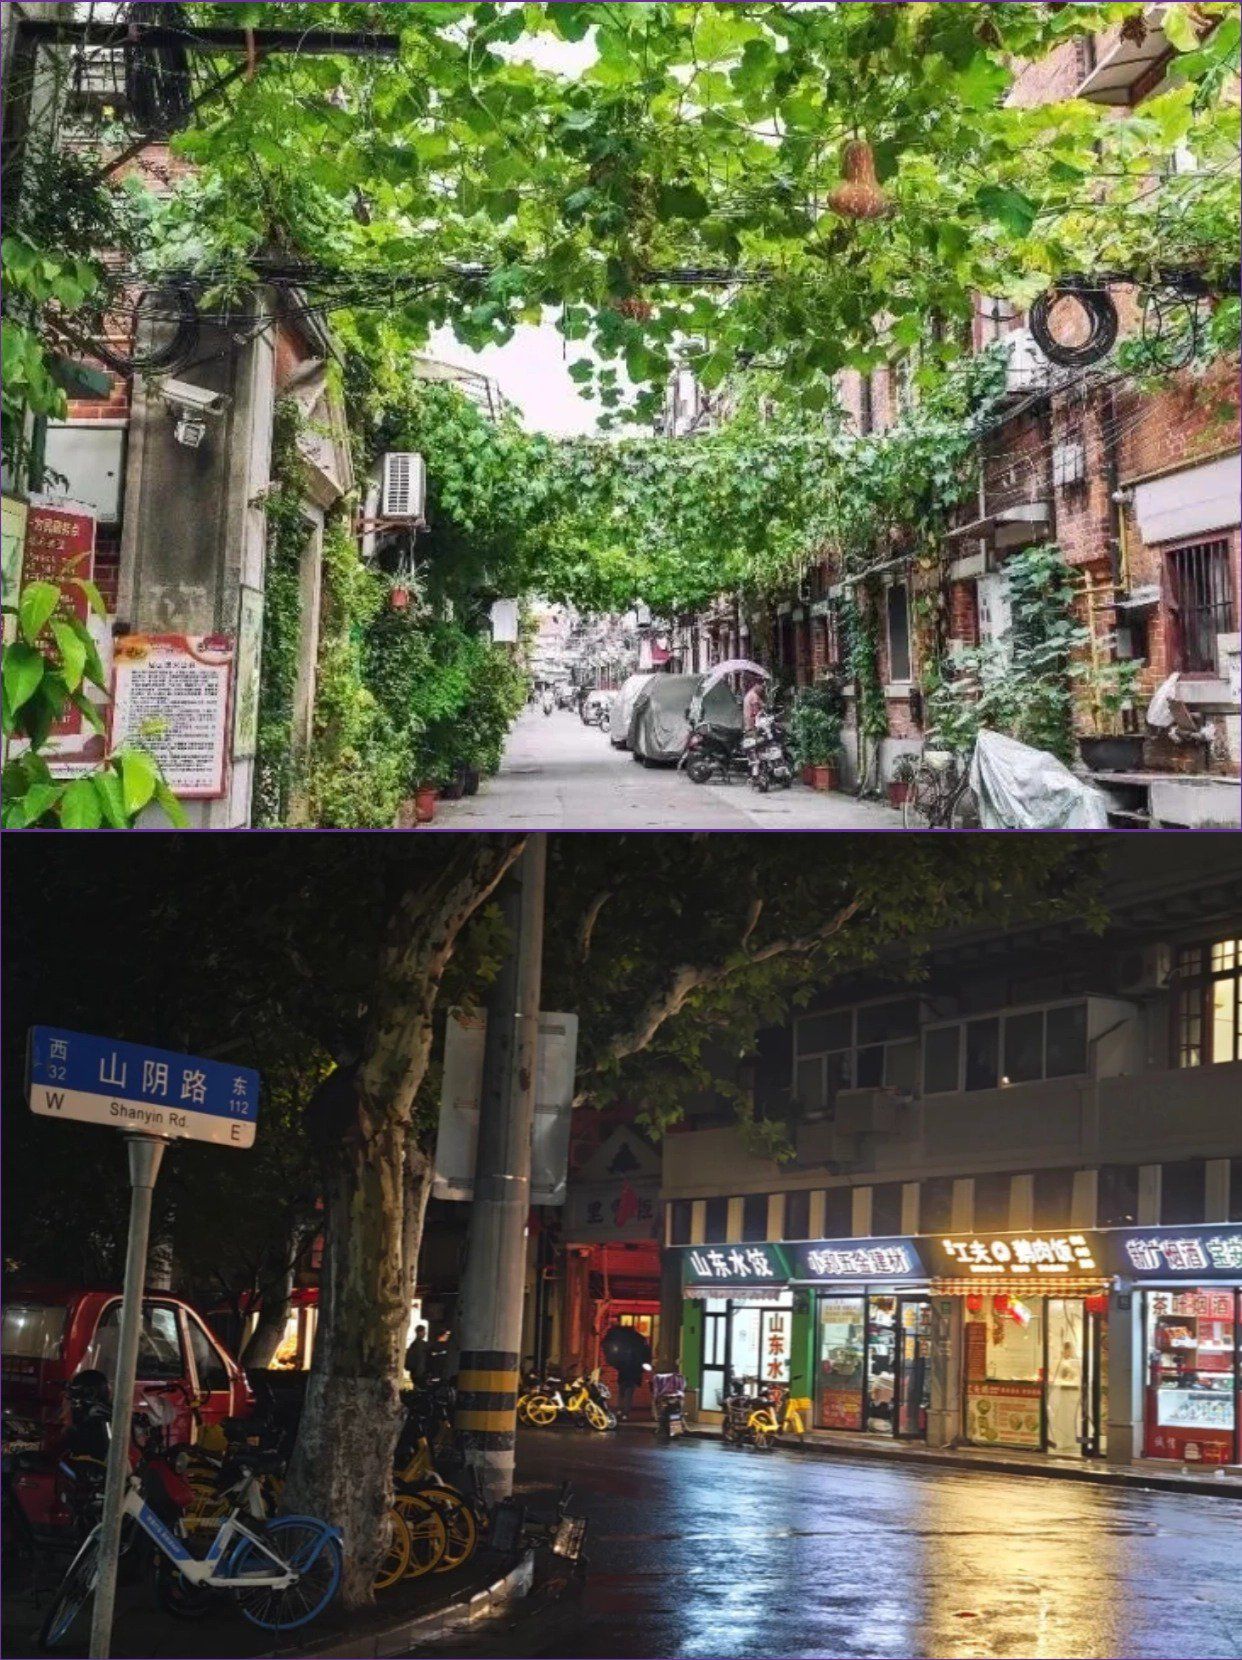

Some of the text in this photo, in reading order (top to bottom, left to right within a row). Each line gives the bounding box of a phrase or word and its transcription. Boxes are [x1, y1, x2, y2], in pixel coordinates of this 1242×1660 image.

[49, 1038, 69, 1061] 西
[49, 1065, 67, 1081] 32
[99, 1052, 207, 1104] 山阴路
[231, 1076, 248, 1097] 东
[45, 1091, 65, 1111] W
[229, 1099, 250, 1115] 112
[109, 1102, 187, 1128] Shanyin Rd
[231, 1124, 242, 1141] E
[690, 1248, 773, 1277] 山东水饺
